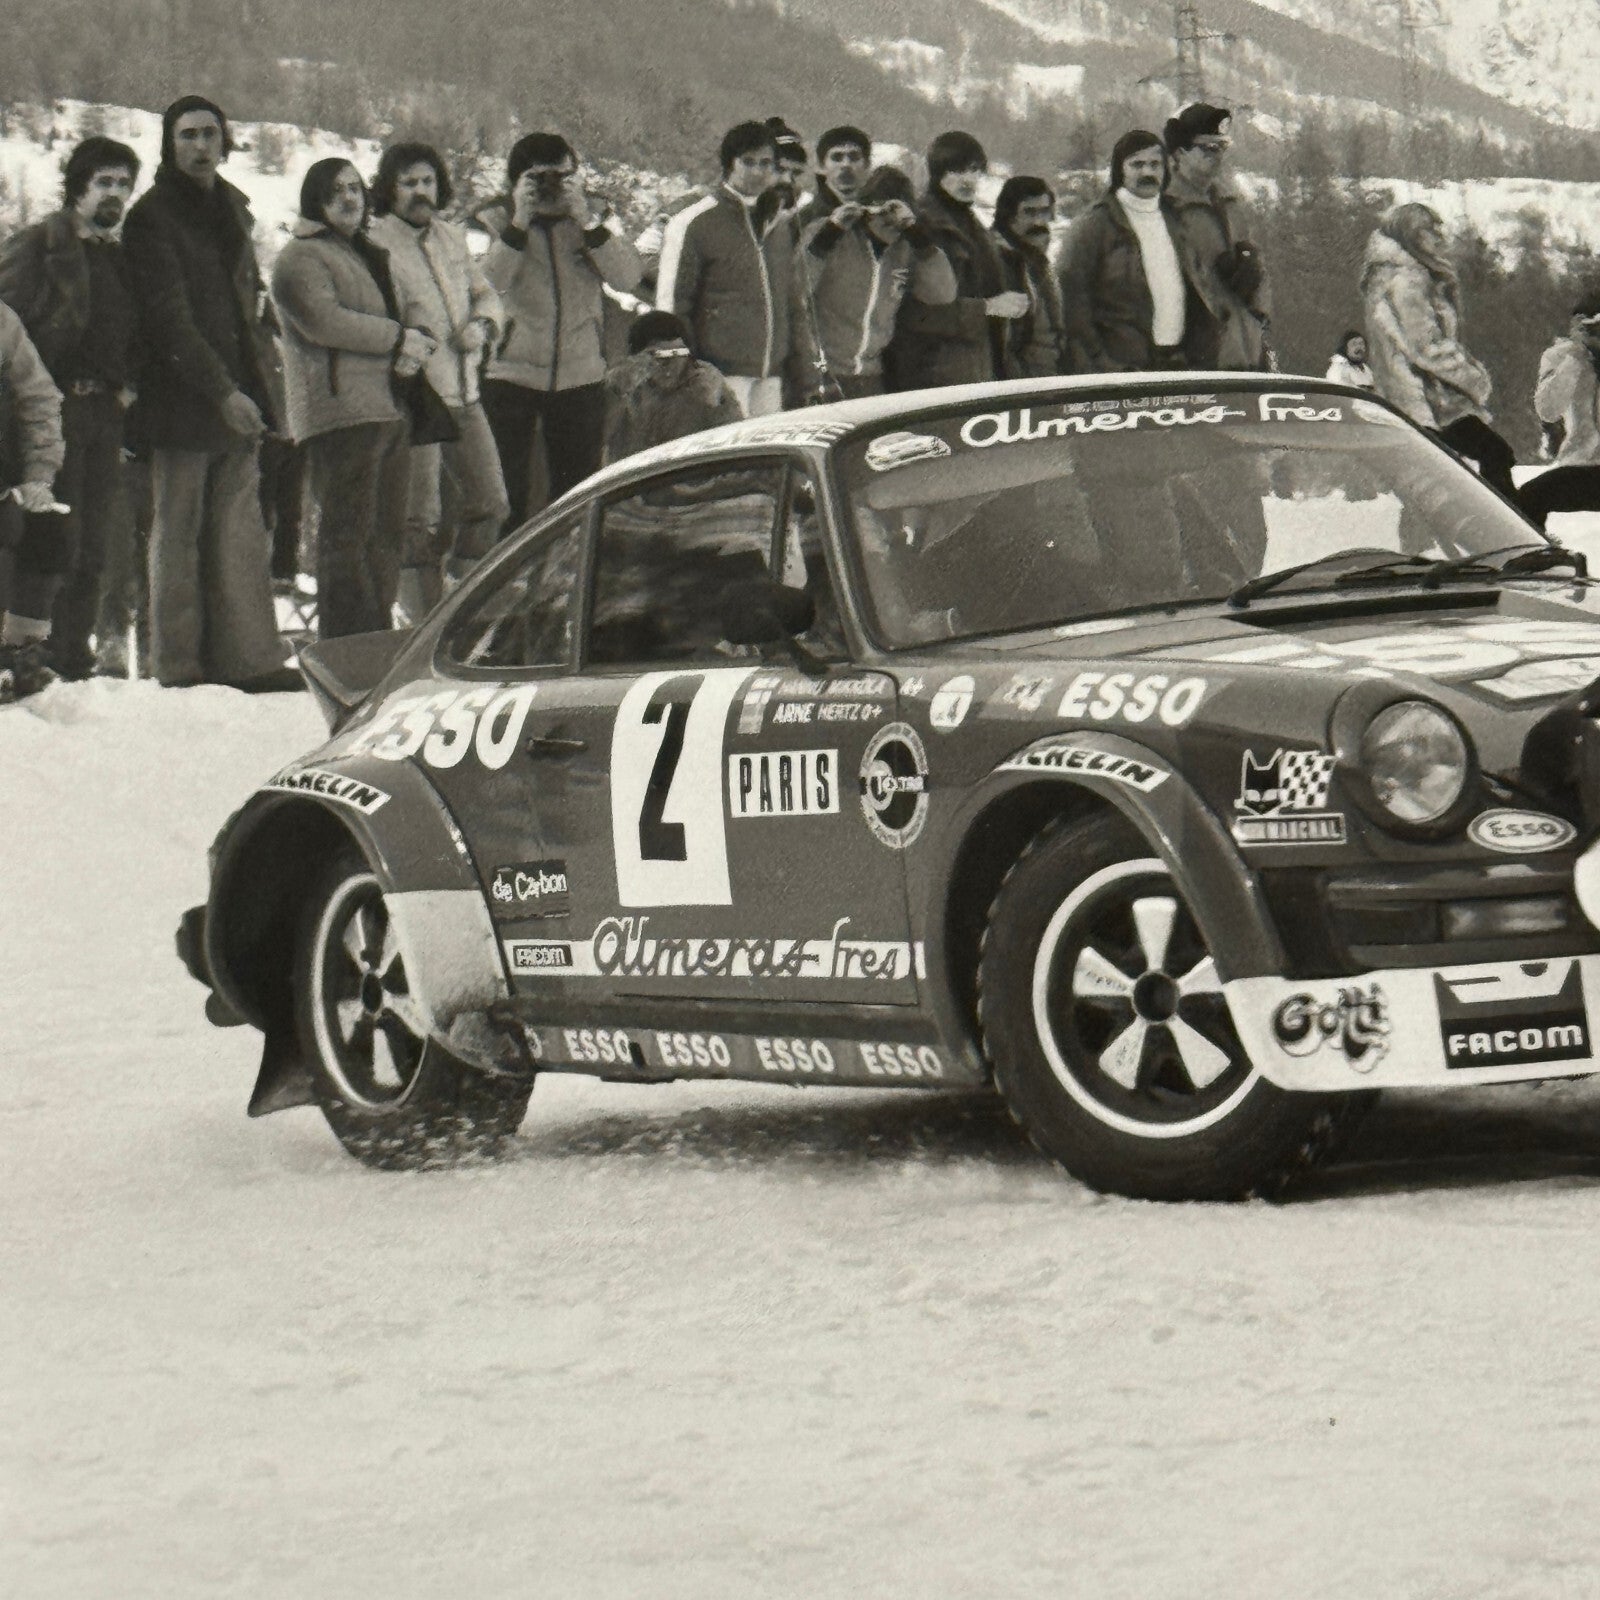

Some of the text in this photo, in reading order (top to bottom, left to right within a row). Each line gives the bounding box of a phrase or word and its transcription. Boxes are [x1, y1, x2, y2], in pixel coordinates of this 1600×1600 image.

[1057, 673, 1208, 725] ESSO
[639, 674, 706, 861] 2
[739, 753, 831, 812] PARIS
[1488, 819, 1558, 840] ESSO
[563, 1029, 632, 1064] ESSO
[656, 1030, 731, 1067] ESSO
[755, 1037, 835, 1073] ESSO
[859, 1042, 944, 1078] ESSO
[1448, 1024, 1583, 1057] FACOM
